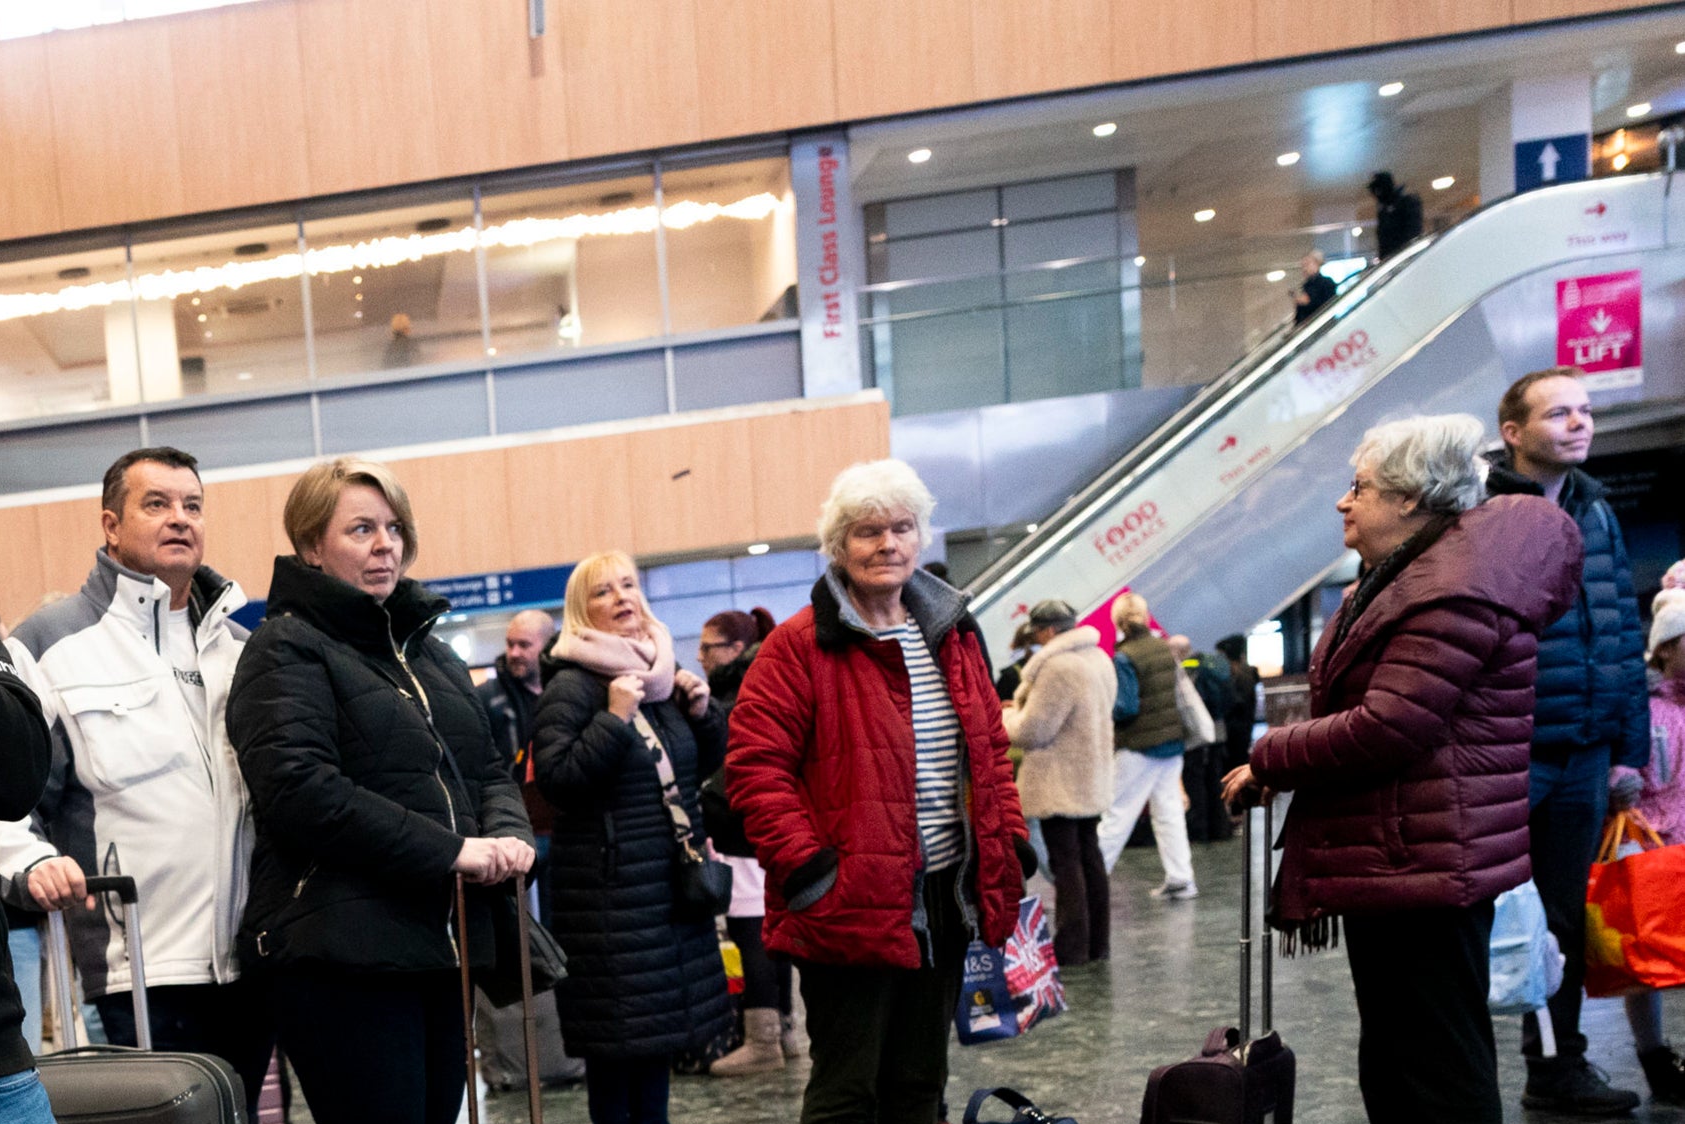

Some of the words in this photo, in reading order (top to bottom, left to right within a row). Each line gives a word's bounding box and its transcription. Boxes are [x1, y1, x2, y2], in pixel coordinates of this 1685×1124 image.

[818, 146, 840, 225] Lounge
[819, 230, 839, 286] Class
[822, 291, 841, 339] First
[1575, 342, 1622, 366] LIFT
[1094, 500, 1159, 557] FOOD
